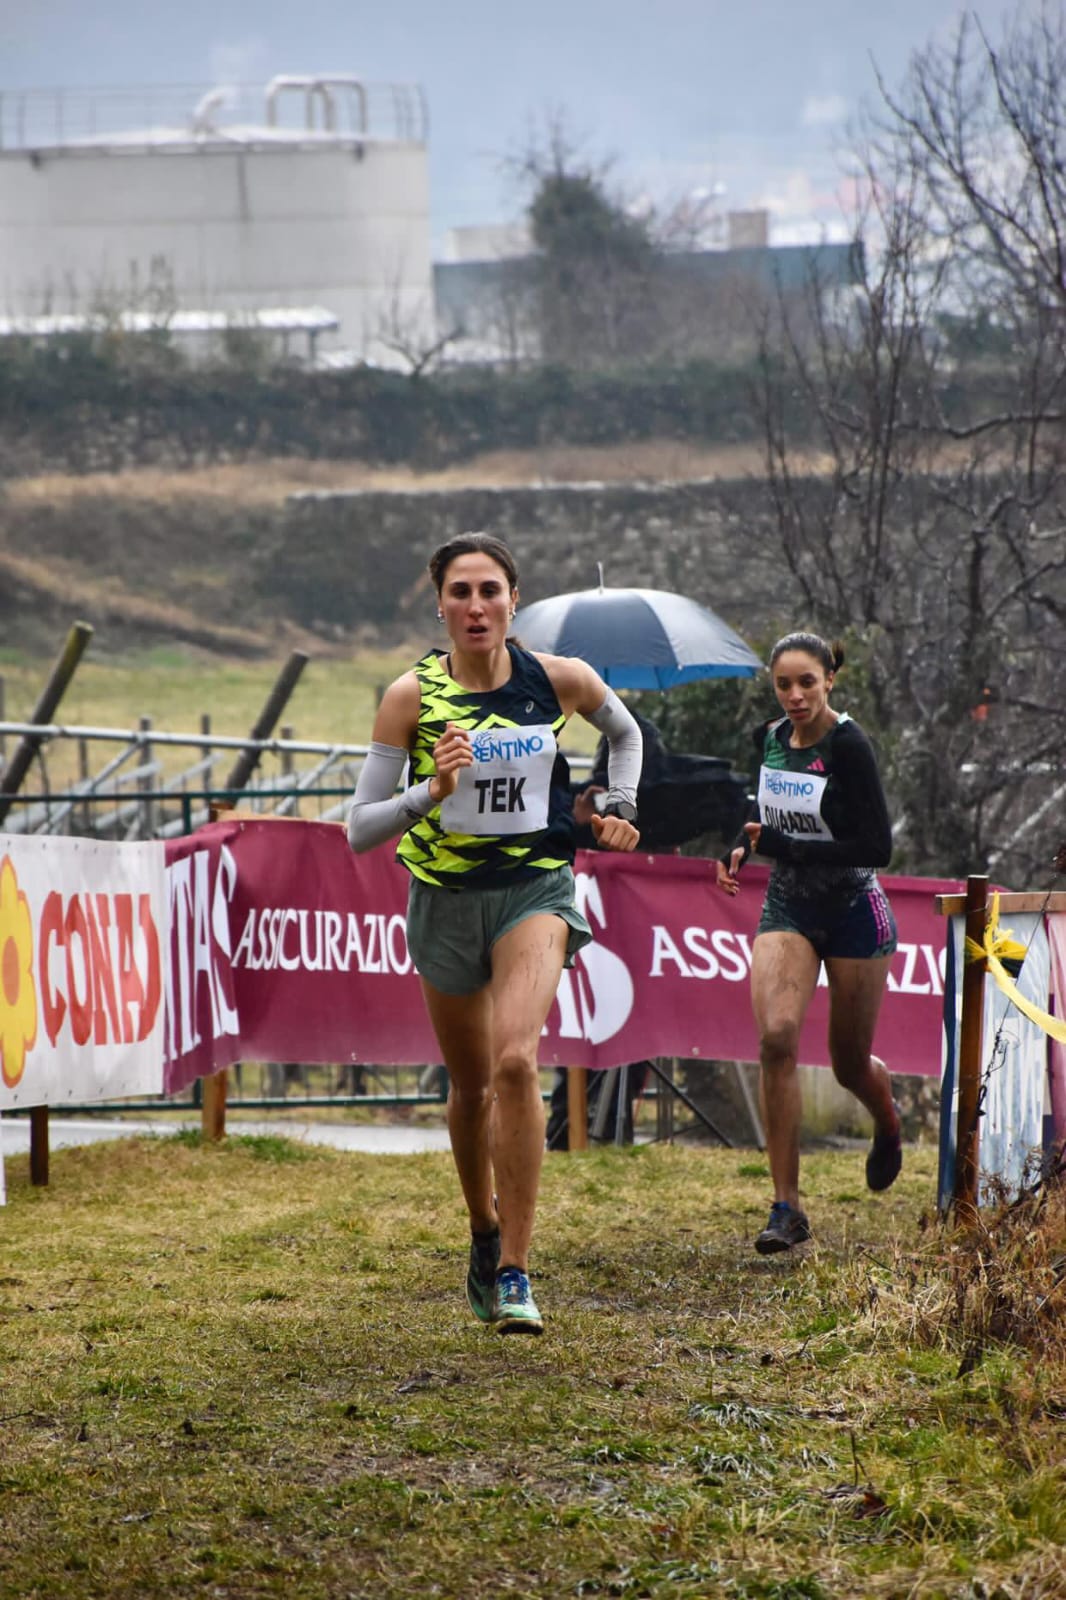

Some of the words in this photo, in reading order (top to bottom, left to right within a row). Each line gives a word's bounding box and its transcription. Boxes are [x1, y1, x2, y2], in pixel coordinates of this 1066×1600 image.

[472, 736, 543, 762] RENTINO
[474, 777, 527, 814] TEK
[765, 773, 814, 797] TRENTINO
[230, 907, 420, 976] ASSICURAZIO
[38, 890, 162, 1048] CONAD
